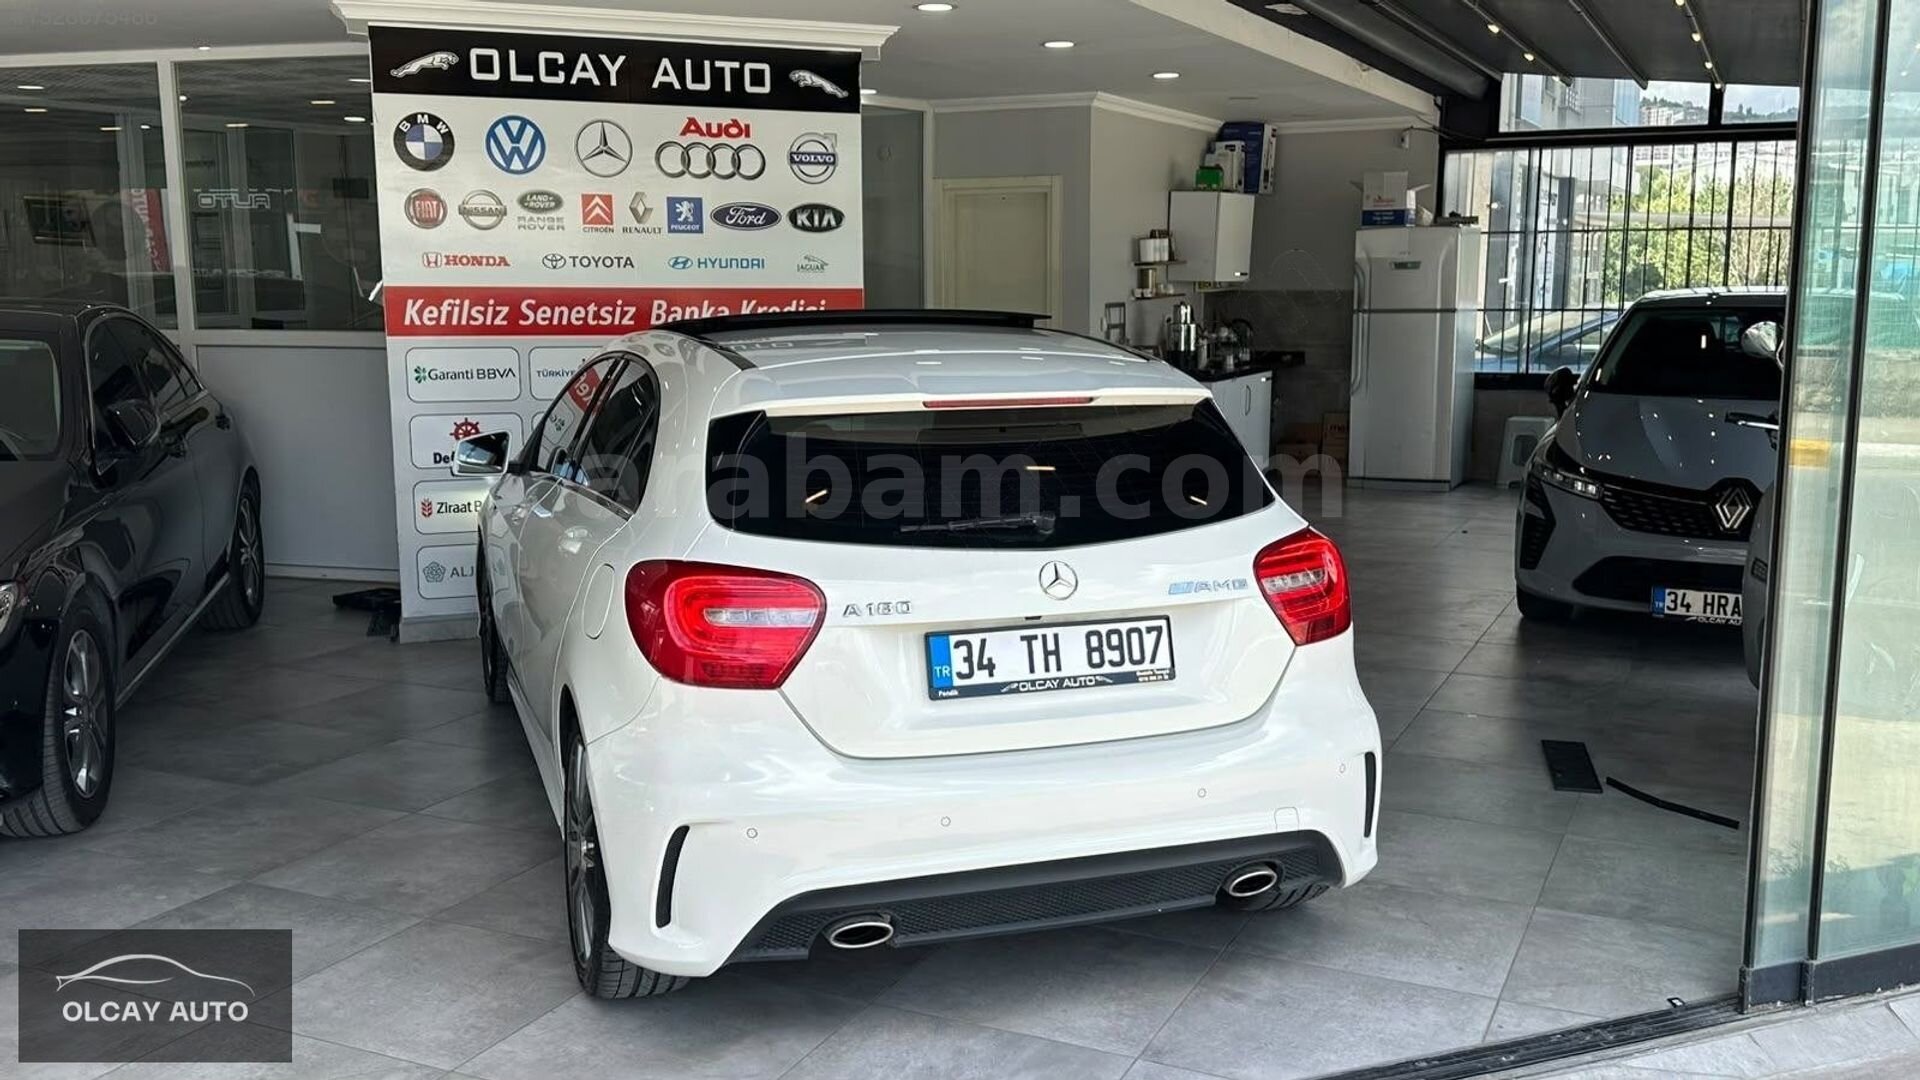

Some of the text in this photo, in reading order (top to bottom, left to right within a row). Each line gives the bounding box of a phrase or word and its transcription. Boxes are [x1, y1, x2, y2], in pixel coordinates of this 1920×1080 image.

[469, 48, 771, 93] OLCAY AUTO
[399, 114, 449, 134] BMW
[680, 116, 750, 138] Audi
[792, 154, 834, 163] VOLVO
[415, 200, 437, 218] FIAT
[463, 205, 502, 215] NISSAN
[726, 207, 766, 225] Ford
[796, 213, 837, 228] KIA
[444, 254, 510, 268] HONDA
[569, 255, 634, 269] TOYOTA
[698, 257, 765, 269] HYUNDAI
[797, 264, 825, 272] JAGUAR
[404, 299, 509, 326] Kefilsiz
[519, 299, 636, 326] Senetsiz
[428, 367, 516, 381] Garanti BBVA
[437, 502, 472, 514] Ziraat
[1666, 591, 1741, 617] 34 HRA
[954, 625, 1163, 680] 34 TH 8907
[934, 665, 951, 679] TR
[1018, 677, 1096, 692] OLCAY AUTO
